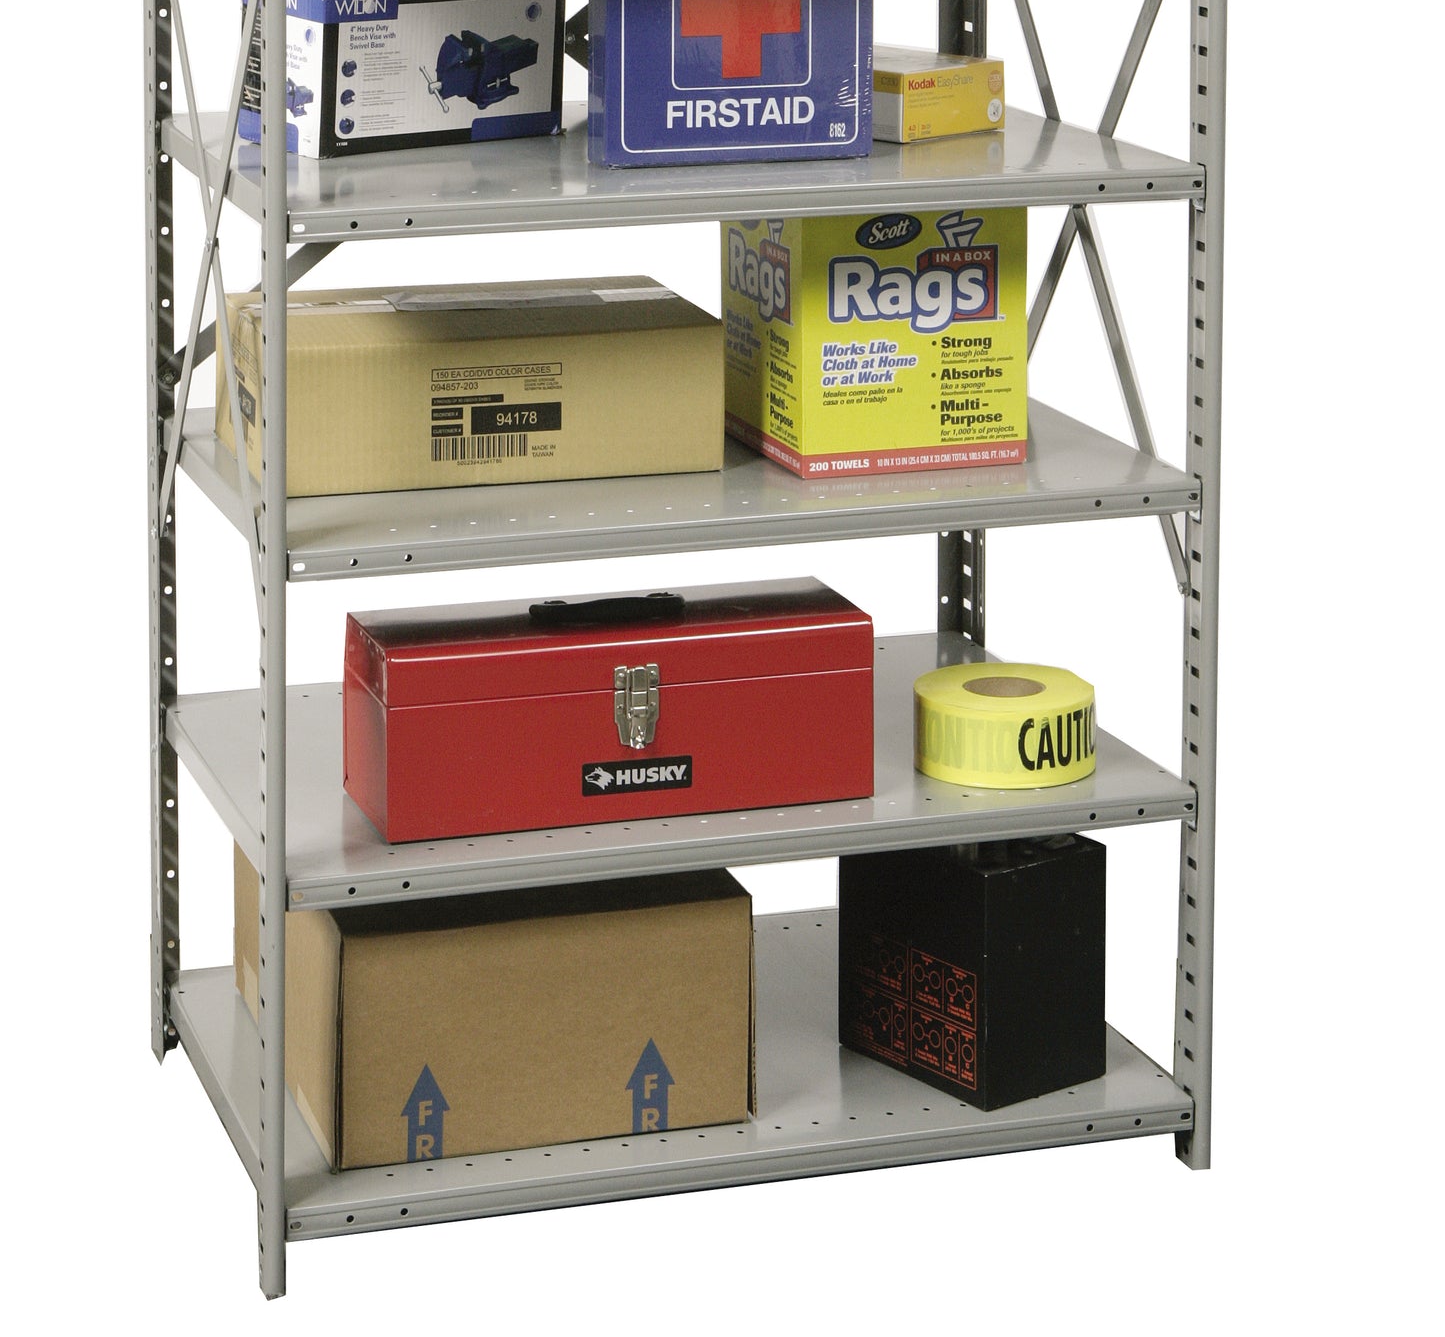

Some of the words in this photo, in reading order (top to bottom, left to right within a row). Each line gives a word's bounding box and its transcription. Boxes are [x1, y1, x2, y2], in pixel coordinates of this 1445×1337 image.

[376, 24, 389, 32] Duty
[350, 42, 370, 50] Swivel
[371, 41, 386, 49] Base
[908, 78, 936, 91] Kodak
[868, 217, 910, 244] Scott
[935, 253, 950, 263] IN
[952, 252, 962, 262] A
[964, 251, 991, 262] BOX
[729, 231, 786, 318] Rags
[833, 261, 986, 330] Rags
[941, 336, 992, 349] Strong
[823, 343, 866, 357] Works
[868, 342, 897, 354] Like
[952, 350, 972, 358] tough
[973, 349, 988, 358] jobs
[823, 358, 858, 371] Cloth
[861, 357, 875, 369] at
[877, 356, 916, 368] Home
[436, 371, 449, 379] 150
[463, 369, 493, 378] CD/DVD
[495, 367, 523, 376] COLOR
[524, 366, 551, 374] CASES
[770, 361, 794, 383] Absorbs
[822, 376, 837, 386] or
[840, 373, 854, 384] at
[857, 370, 894, 383] Work
[941, 366, 1003, 380] Absorbs
[431, 382, 478, 392] 094857-203
[960, 382, 986, 390] sponge
[864, 396, 887, 404] trabajo
[496, 411, 538, 426] 94178
[770, 404, 794, 429] Purpose
[941, 413, 1003, 427] Purpose
[953, 427, 976, 436] 1,000's
[978, 426, 986, 434] of
[986, 425, 1014, 434] projects
[809, 462, 829, 471] 200
[831, 459, 870, 470] TOWELS
[616, 765, 687, 786] HUSKY
